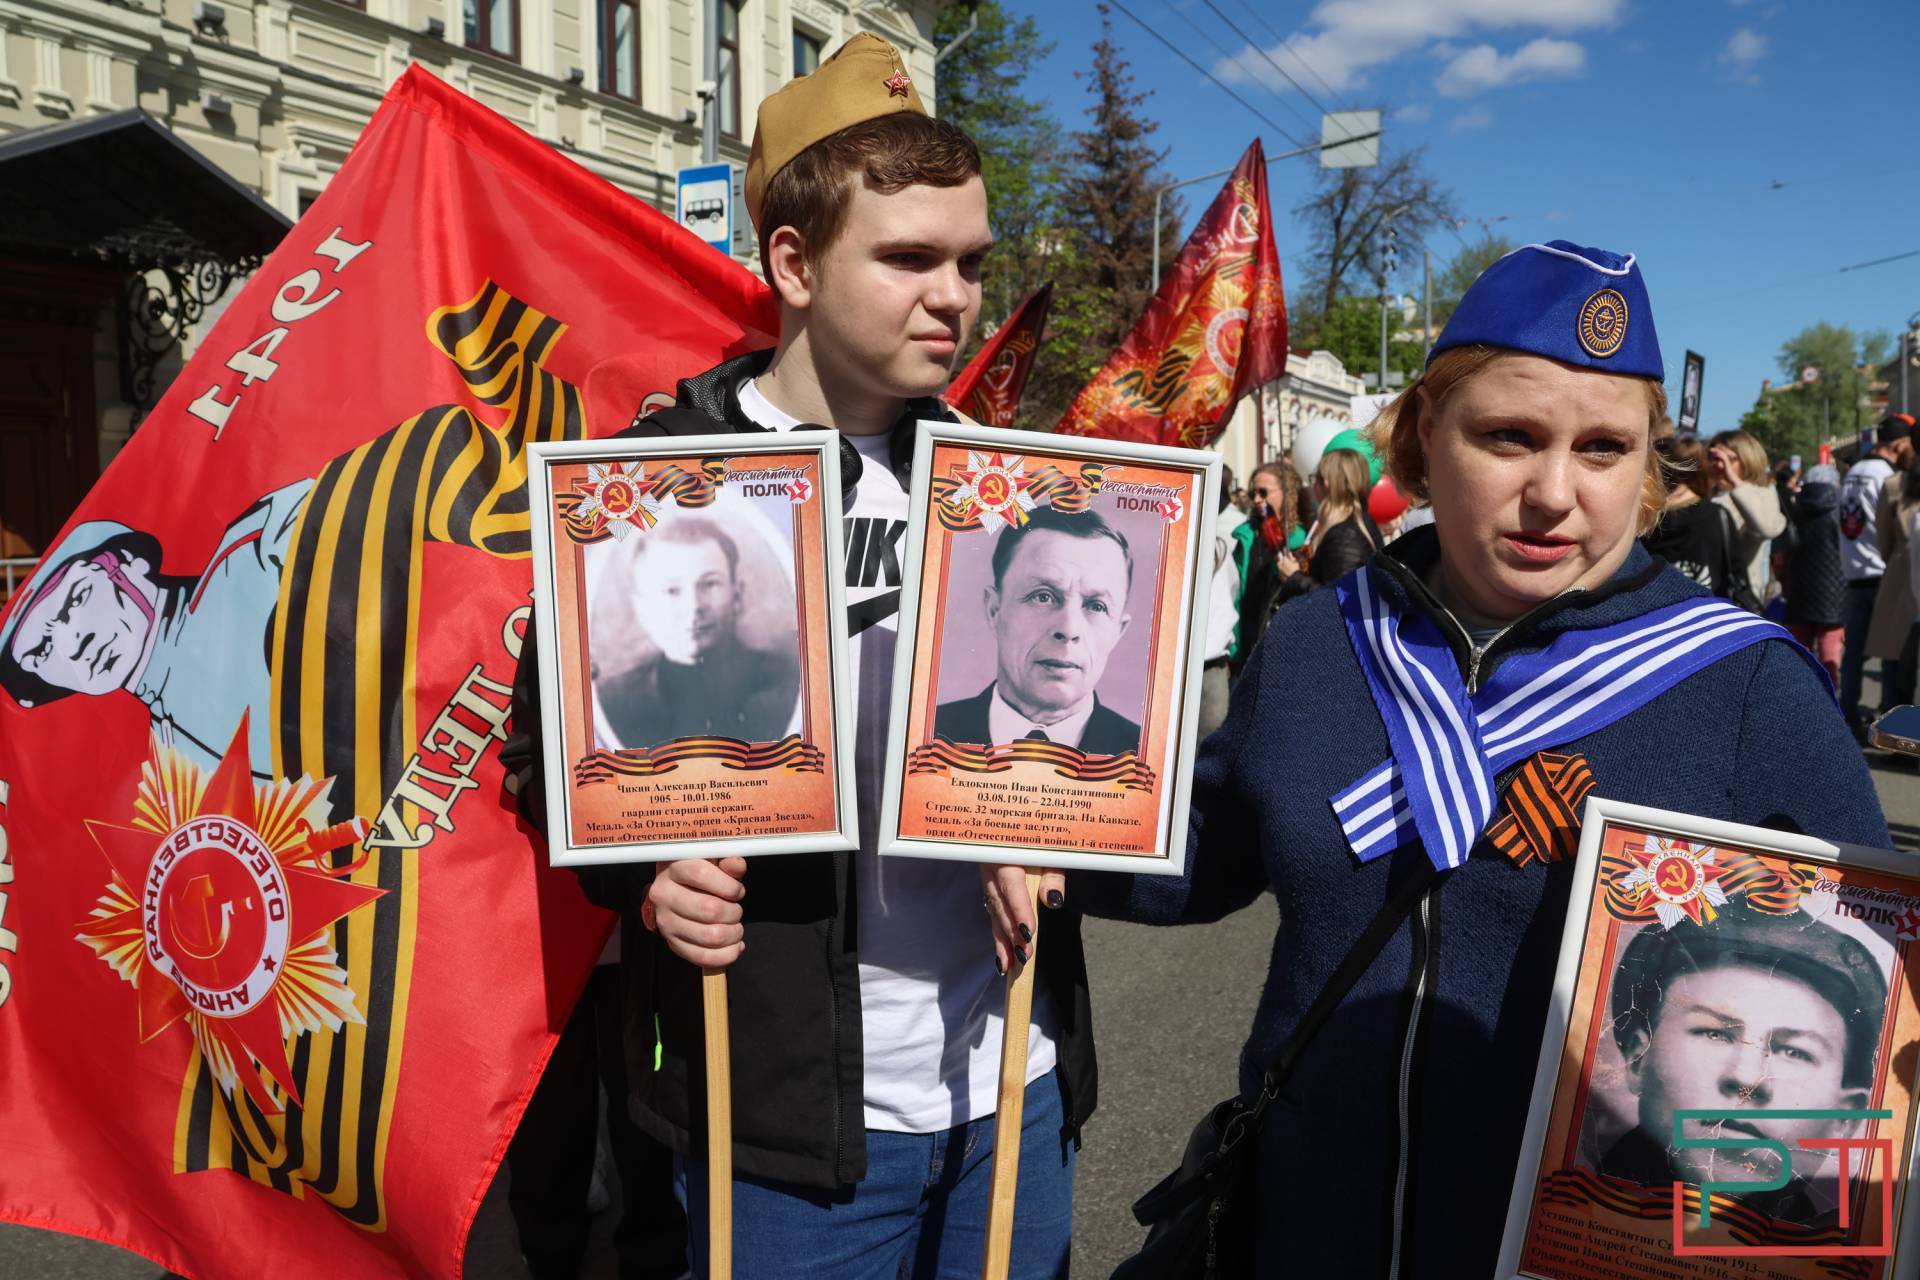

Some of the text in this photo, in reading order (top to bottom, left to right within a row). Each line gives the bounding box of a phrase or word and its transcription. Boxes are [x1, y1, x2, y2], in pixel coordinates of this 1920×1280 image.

[743, 483, 788, 497] ПОЛК
[1116, 496, 1160, 513] ПОЛК
[843, 517, 908, 588] IK
[617, 778, 768, 794] Чикин Александр Васильевич
[951, 777, 1125, 800] Евдокимов Иван Константинович
[650, 795, 671, 804] 1905
[682, 792, 731, 803] 10.01.1986
[978, 792, 1029, 805] 03.08.1916
[1040, 798, 1092, 810] 22.04.1990
[665, 805, 709, 816] старший
[711, 803, 754, 814] сержант.
[975, 805, 987, 814] 32
[990, 808, 1032, 820] морская
[1082, 814, 1095, 823] На
[1098, 814, 1142, 827] Кавказе.
[586, 821, 624, 831] Медаль
[626, 821, 643, 829] «За
[693, 817, 721, 827] орден
[724, 814, 771, 825] «Красная
[924, 816, 962, 826] медаль
[964, 817, 982, 826] «За
[984, 818, 1020, 829] боевые
[586, 834, 615, 844] орден
[617, 829, 697, 841] «Отечественной
[701, 829, 733, 837] войны
[736, 826, 750, 836] 2-й
[926, 828, 956, 839] орден
[958, 830, 1041, 844] «Отечественной
[1044, 836, 1078, 846] войны
[1835, 900, 1896, 926] ПОЛК
